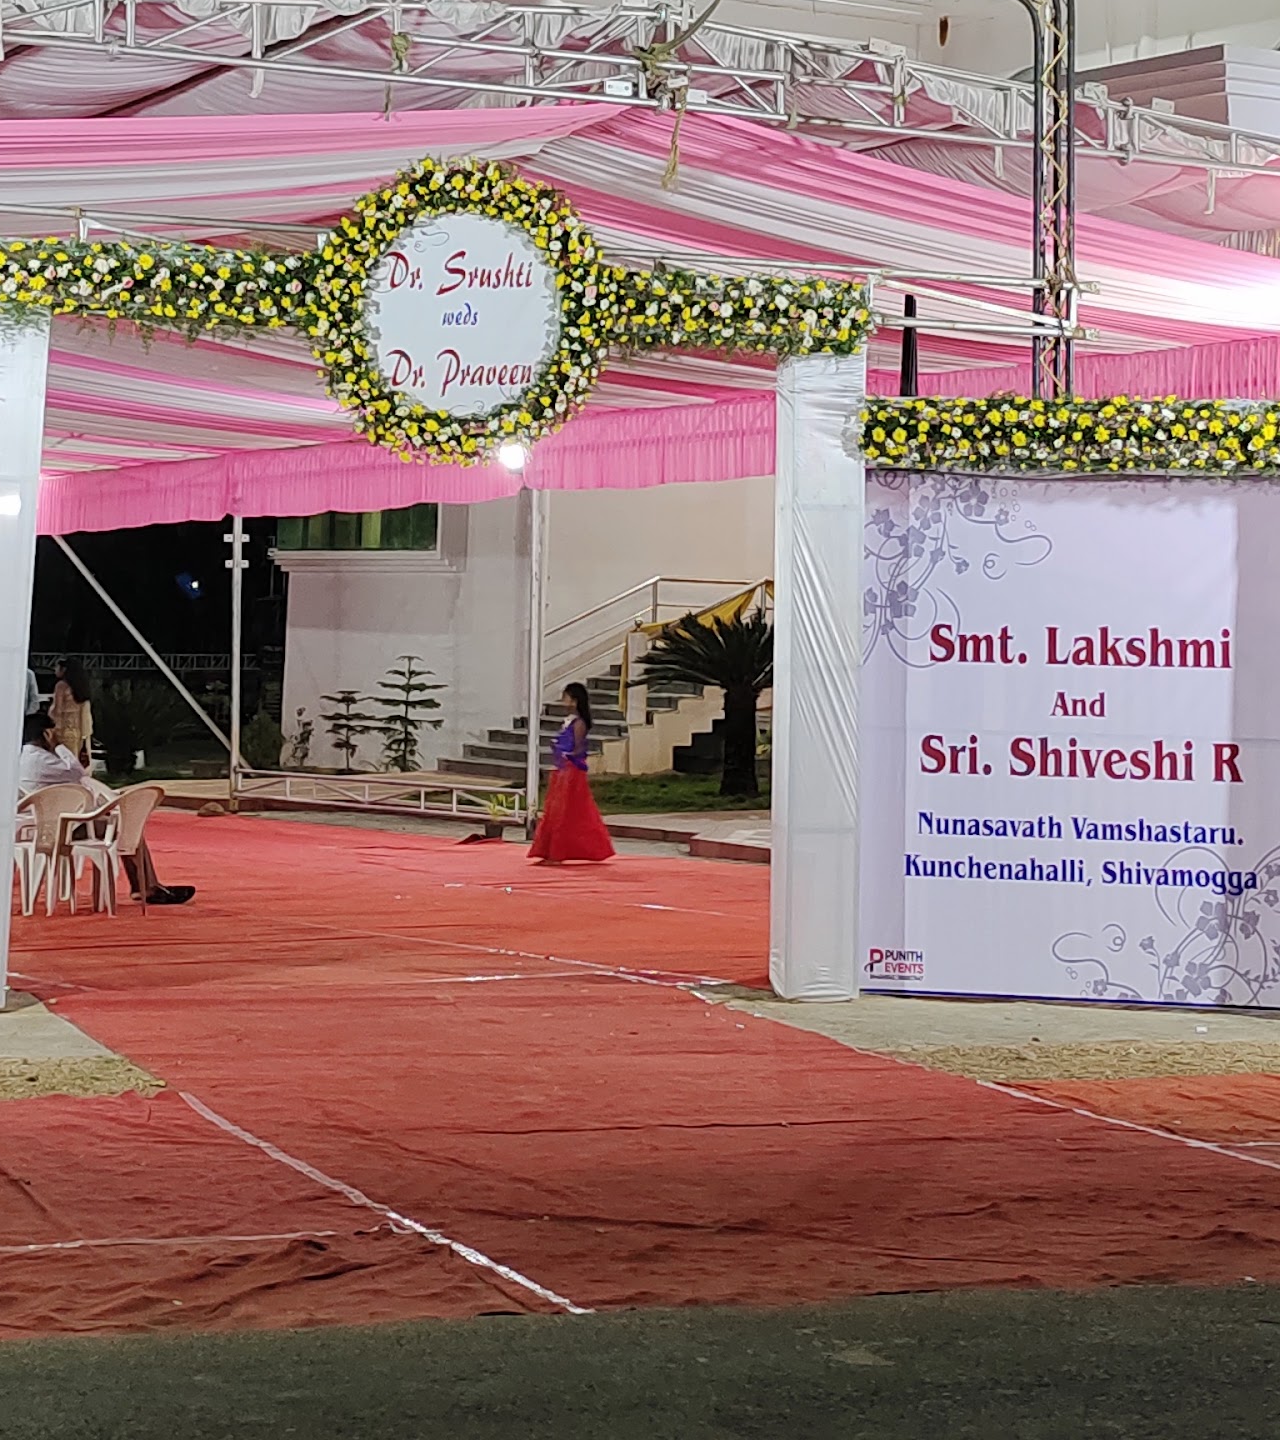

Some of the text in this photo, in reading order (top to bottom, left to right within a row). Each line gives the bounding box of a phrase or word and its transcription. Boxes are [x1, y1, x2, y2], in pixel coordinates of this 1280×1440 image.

[384, 251, 533, 295] Dr. Srushti
[442, 303, 479, 326] weds
[386, 349, 531, 397] Dr. Praveen
[930, 624, 1232, 668] Smt. Lakshmi
[1050, 692, 1106, 717] And
[920, 735, 1244, 782] Sri. Shiveshi R
[918, 812, 1244, 846] Nunasavath Vamshastaru.
[904, 854, 1258, 895] Kunchenahalli, Shivamogga
[885, 950, 923, 962] PUNITH
[885, 962, 924, 974] EVENTS
